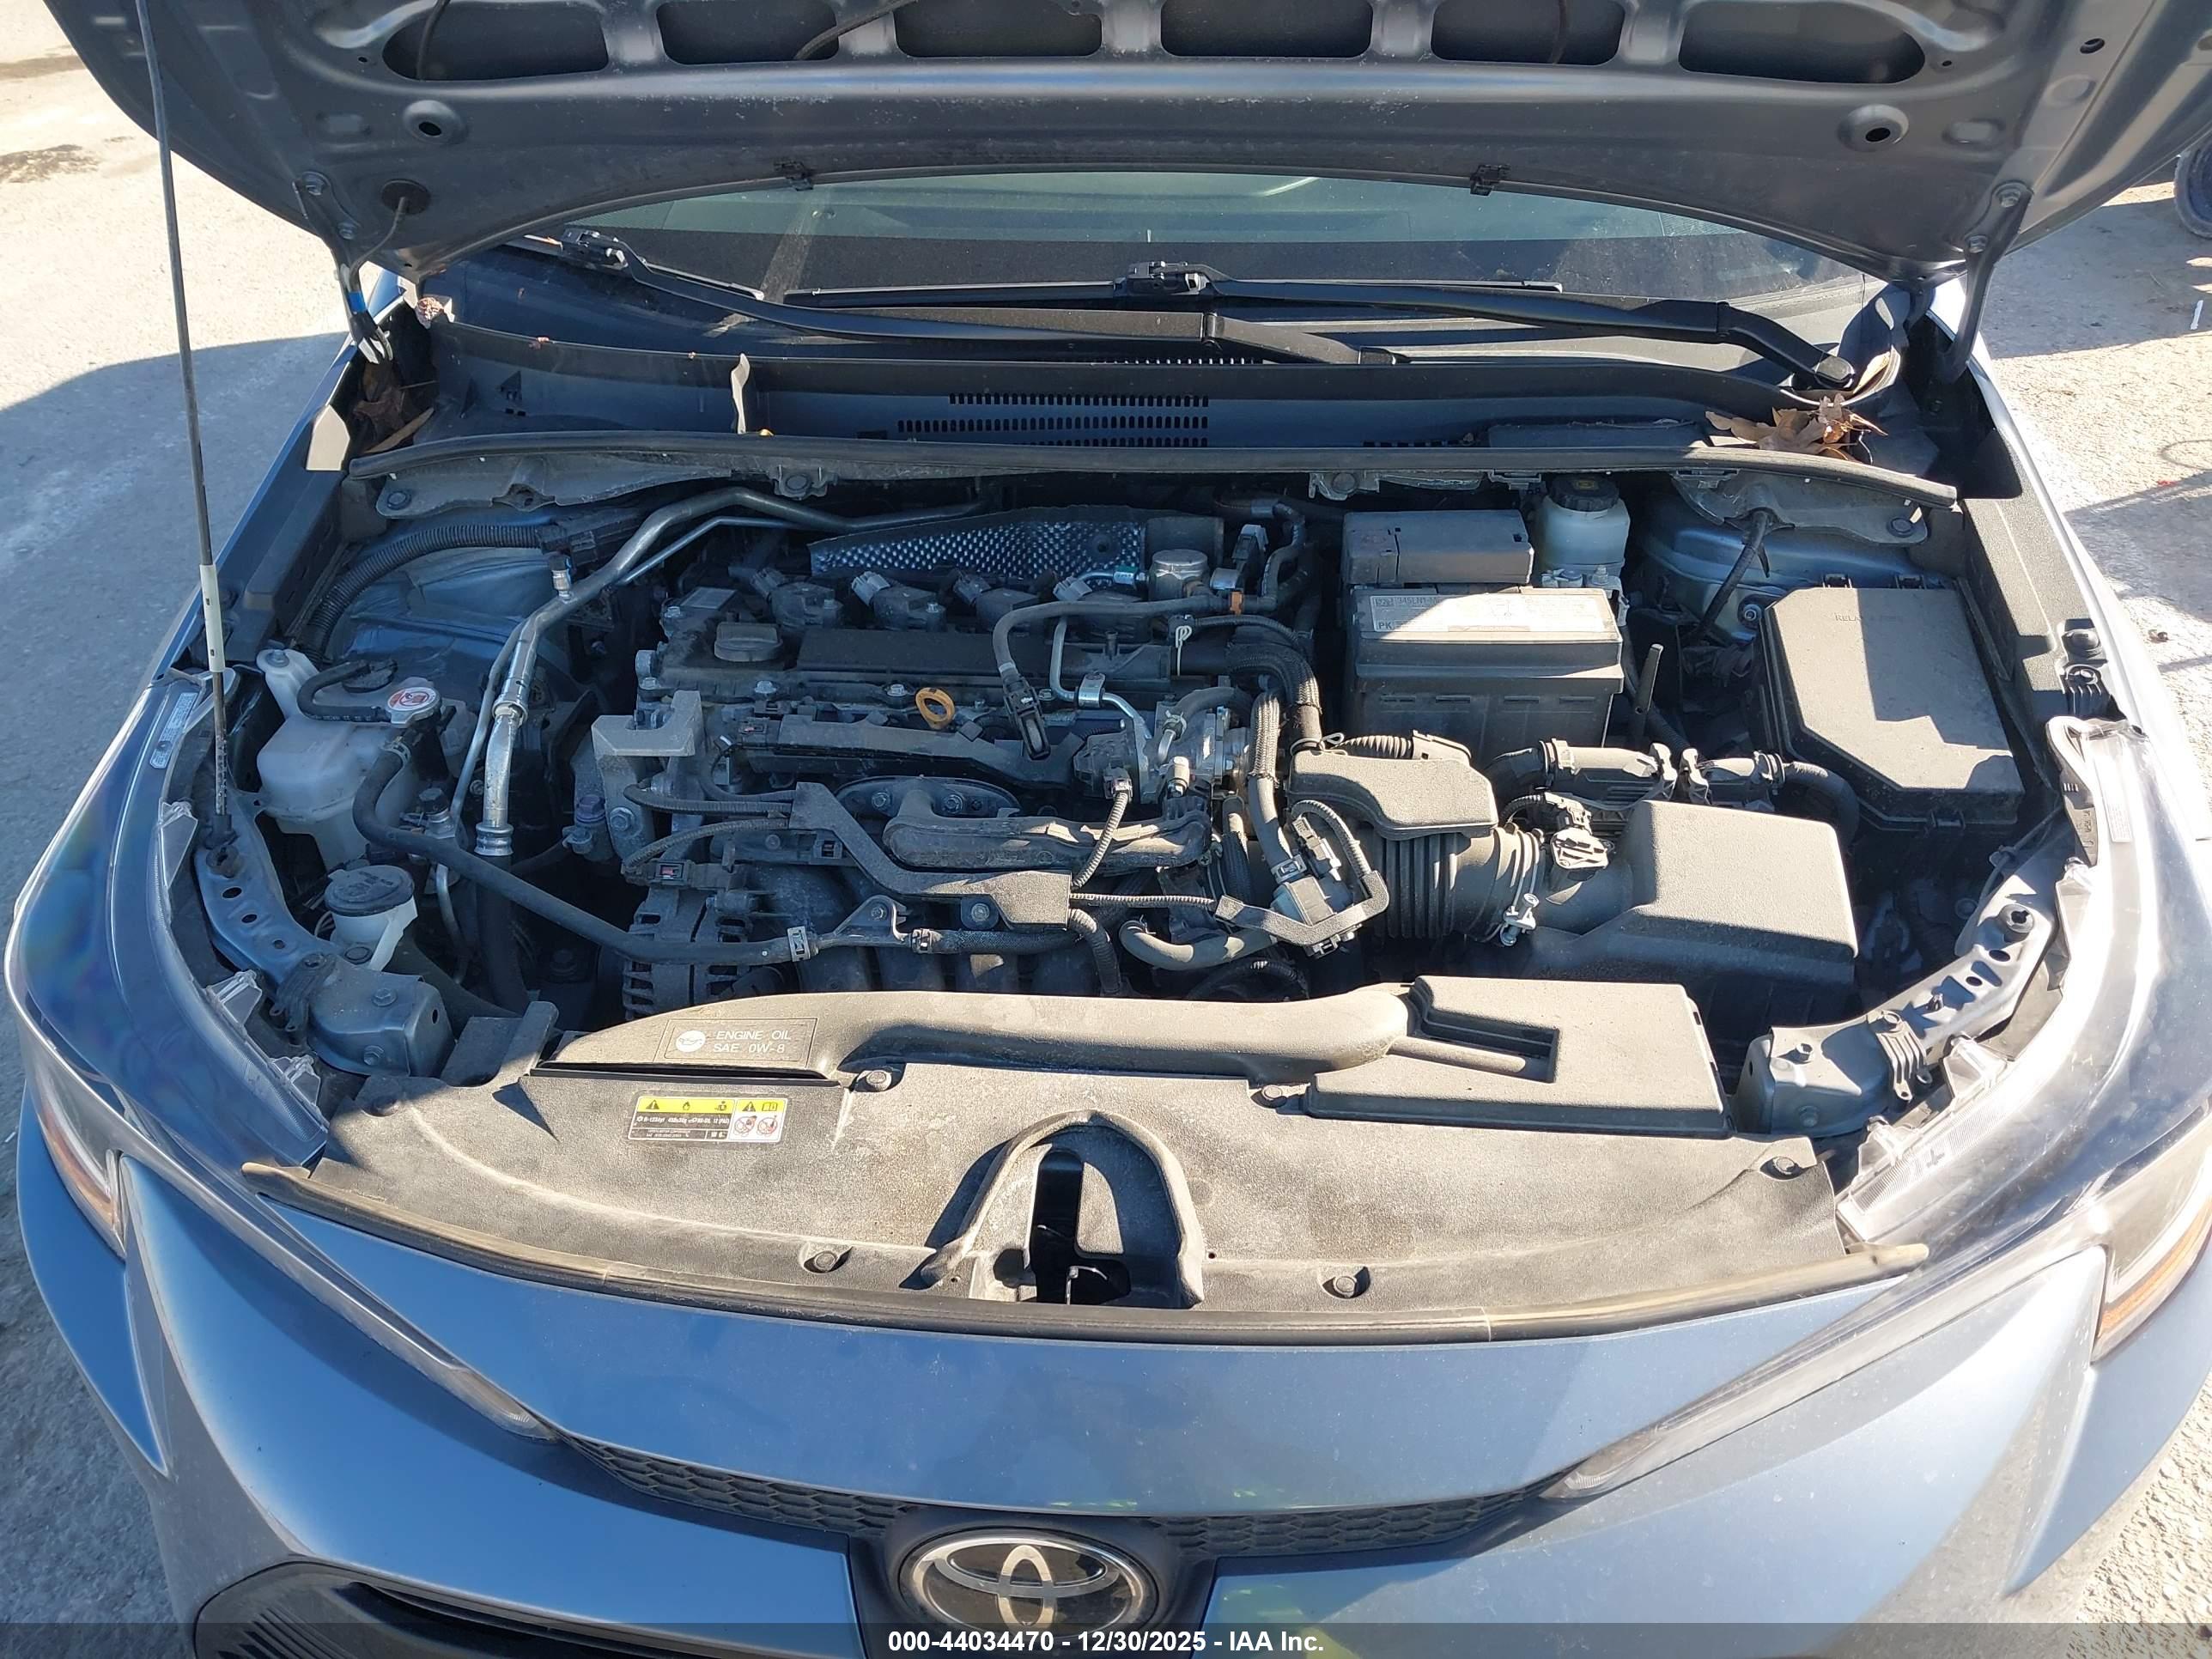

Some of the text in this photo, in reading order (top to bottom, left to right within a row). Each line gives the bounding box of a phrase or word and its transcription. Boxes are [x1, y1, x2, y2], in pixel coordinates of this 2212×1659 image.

[1378, 621, 1392, 629] PK
[715, 1030, 792, 1041] ENGINE OIL
[713, 1042, 786, 1054] SAE 0W-8
